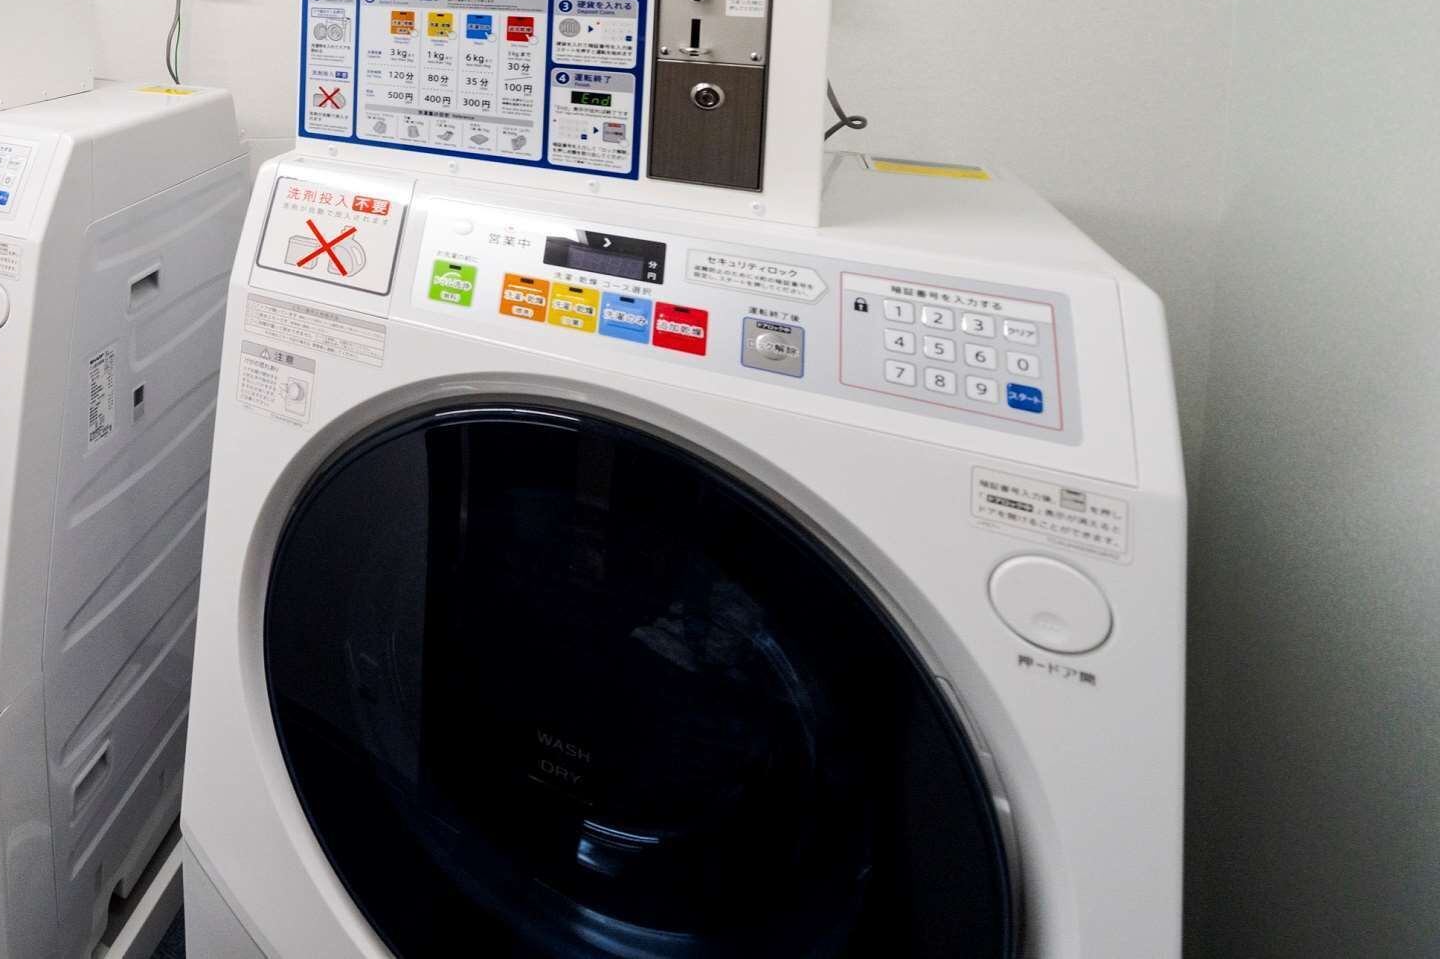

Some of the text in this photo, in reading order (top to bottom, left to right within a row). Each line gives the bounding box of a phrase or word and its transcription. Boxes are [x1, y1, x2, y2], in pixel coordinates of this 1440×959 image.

[577, 0, 632, 10] 硬貨を入れる
[574, 73, 611, 84] 運転終了
[580, 93, 610, 106] End
[287, 186, 387, 214] 洗剤投入 不要
[488, 232, 531, 249] 営業中
[707, 256, 798, 278] セキュリティロック
[890, 284, 1003, 311] 暗証番号を入力する
[749, 306, 800, 323] 運転終了後
[895, 305, 902, 317] 1
[933, 312, 944, 325] 2
[973, 318, 985, 332] 3
[893, 335, 1030, 372] 4 5 6 0
[894, 367, 1041, 405] 7 8 9 スタート
[536, 727, 591, 763] WASH
[540, 759, 583, 785] DRY
